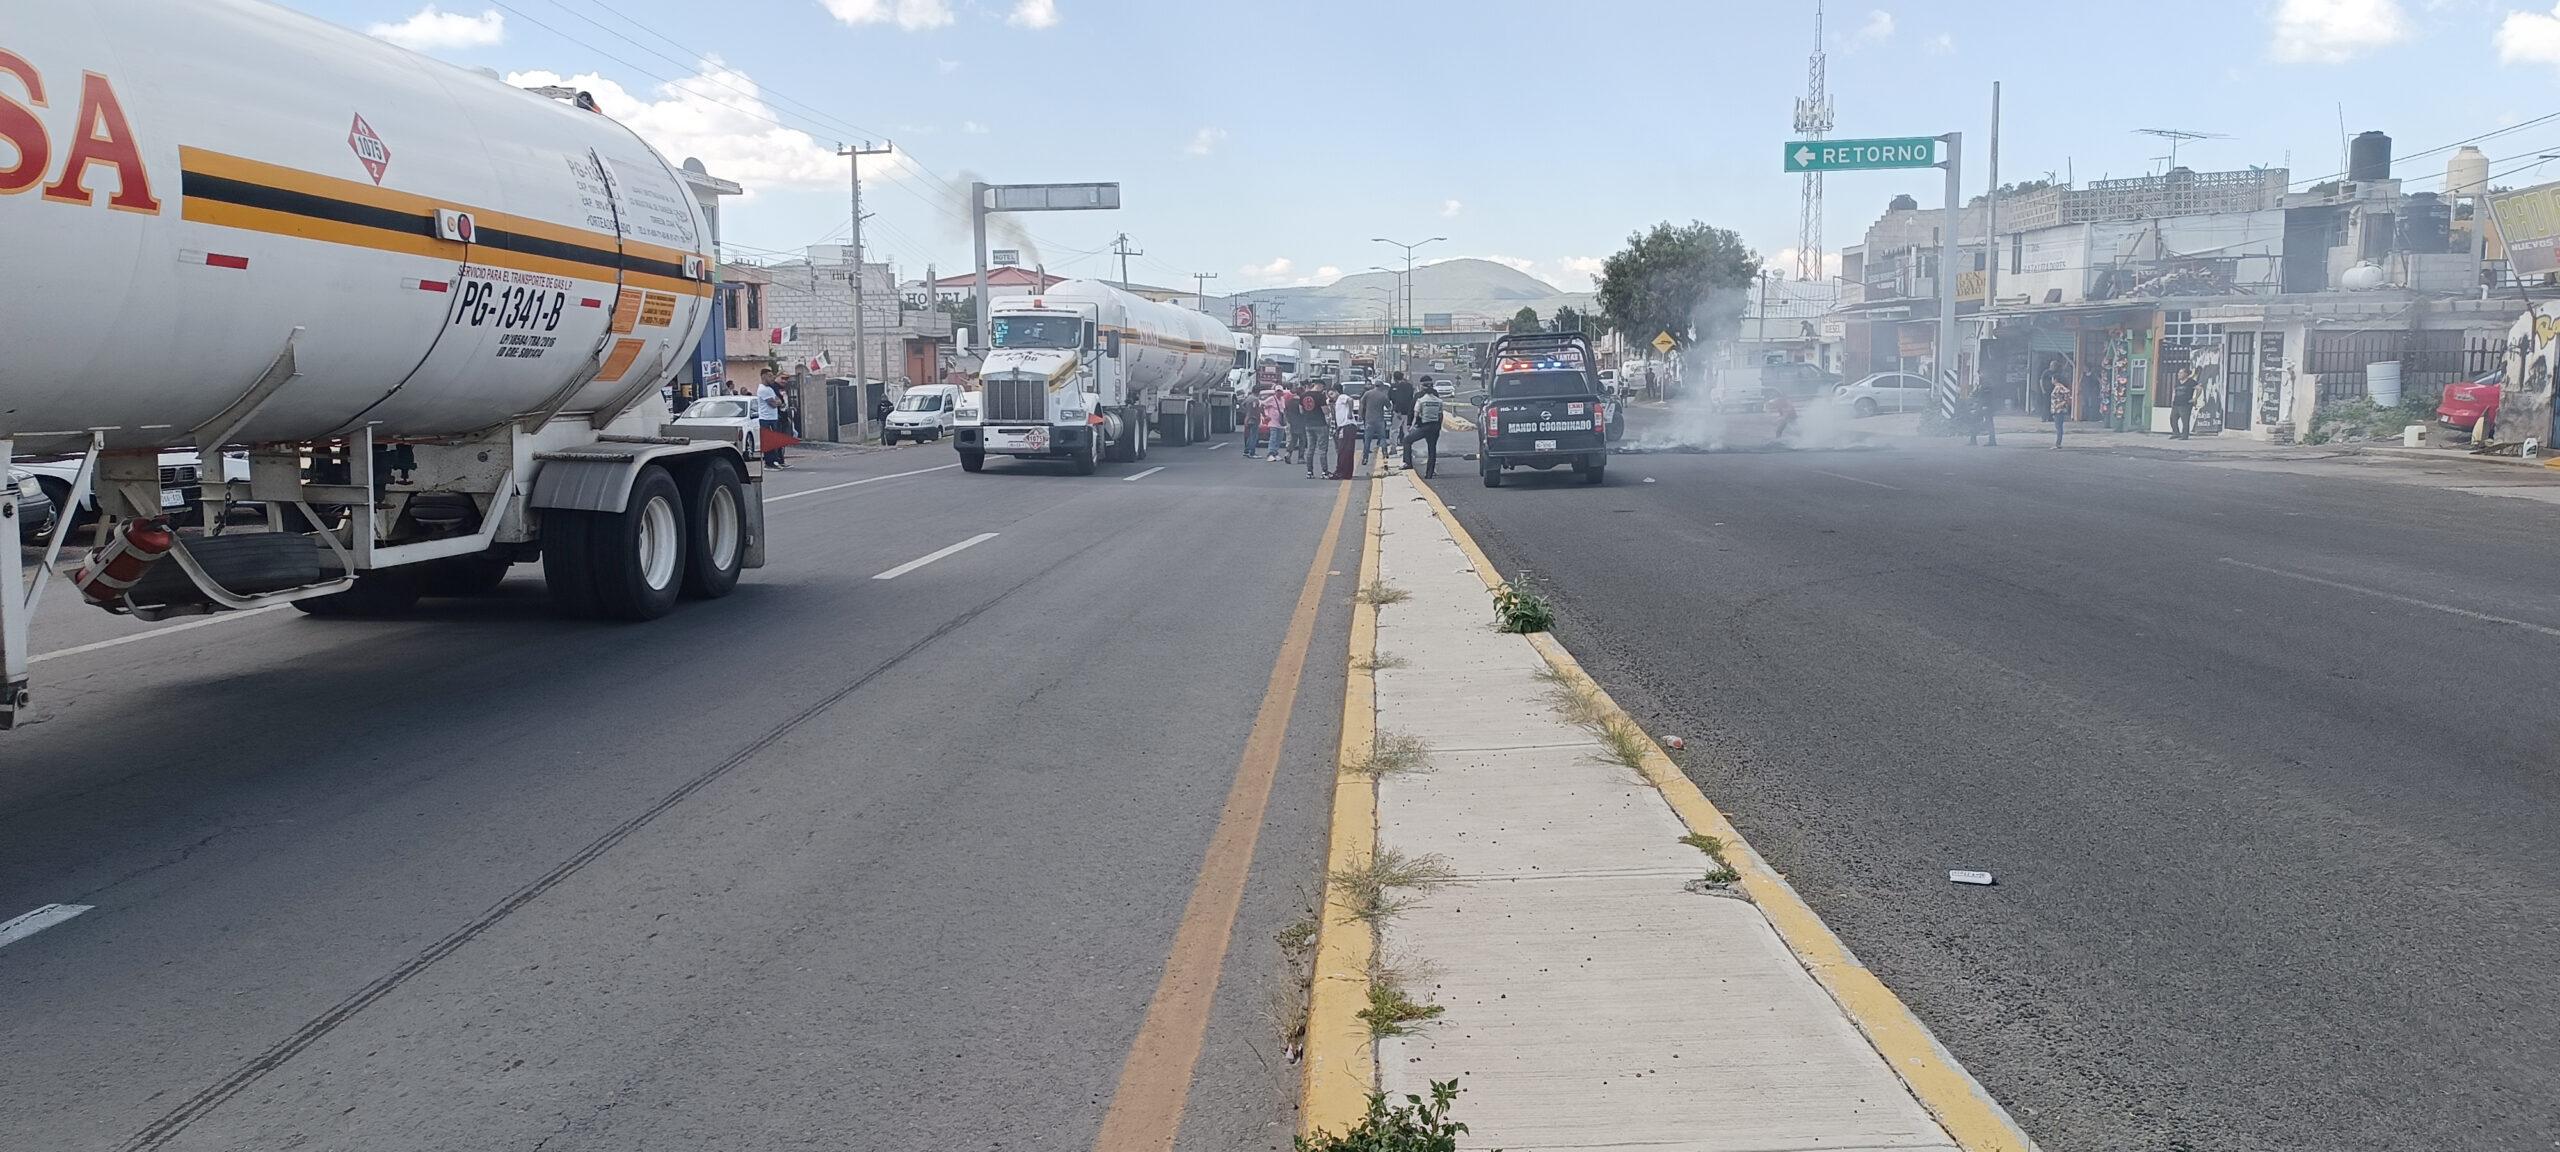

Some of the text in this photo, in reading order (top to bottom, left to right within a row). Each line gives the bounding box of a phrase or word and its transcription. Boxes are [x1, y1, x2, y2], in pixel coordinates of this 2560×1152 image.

[358, 136, 382, 160] 1075
[1823, 145, 1927, 164] RETORNO
[486, 269, 502, 282] PARA
[502, 271, 510, 282] EL
[511, 272, 546, 288] TRANSPORTE
[455, 281, 565, 331] PG-1341-B
[1508, 420, 1591, 433] MANDO COORDINADO
